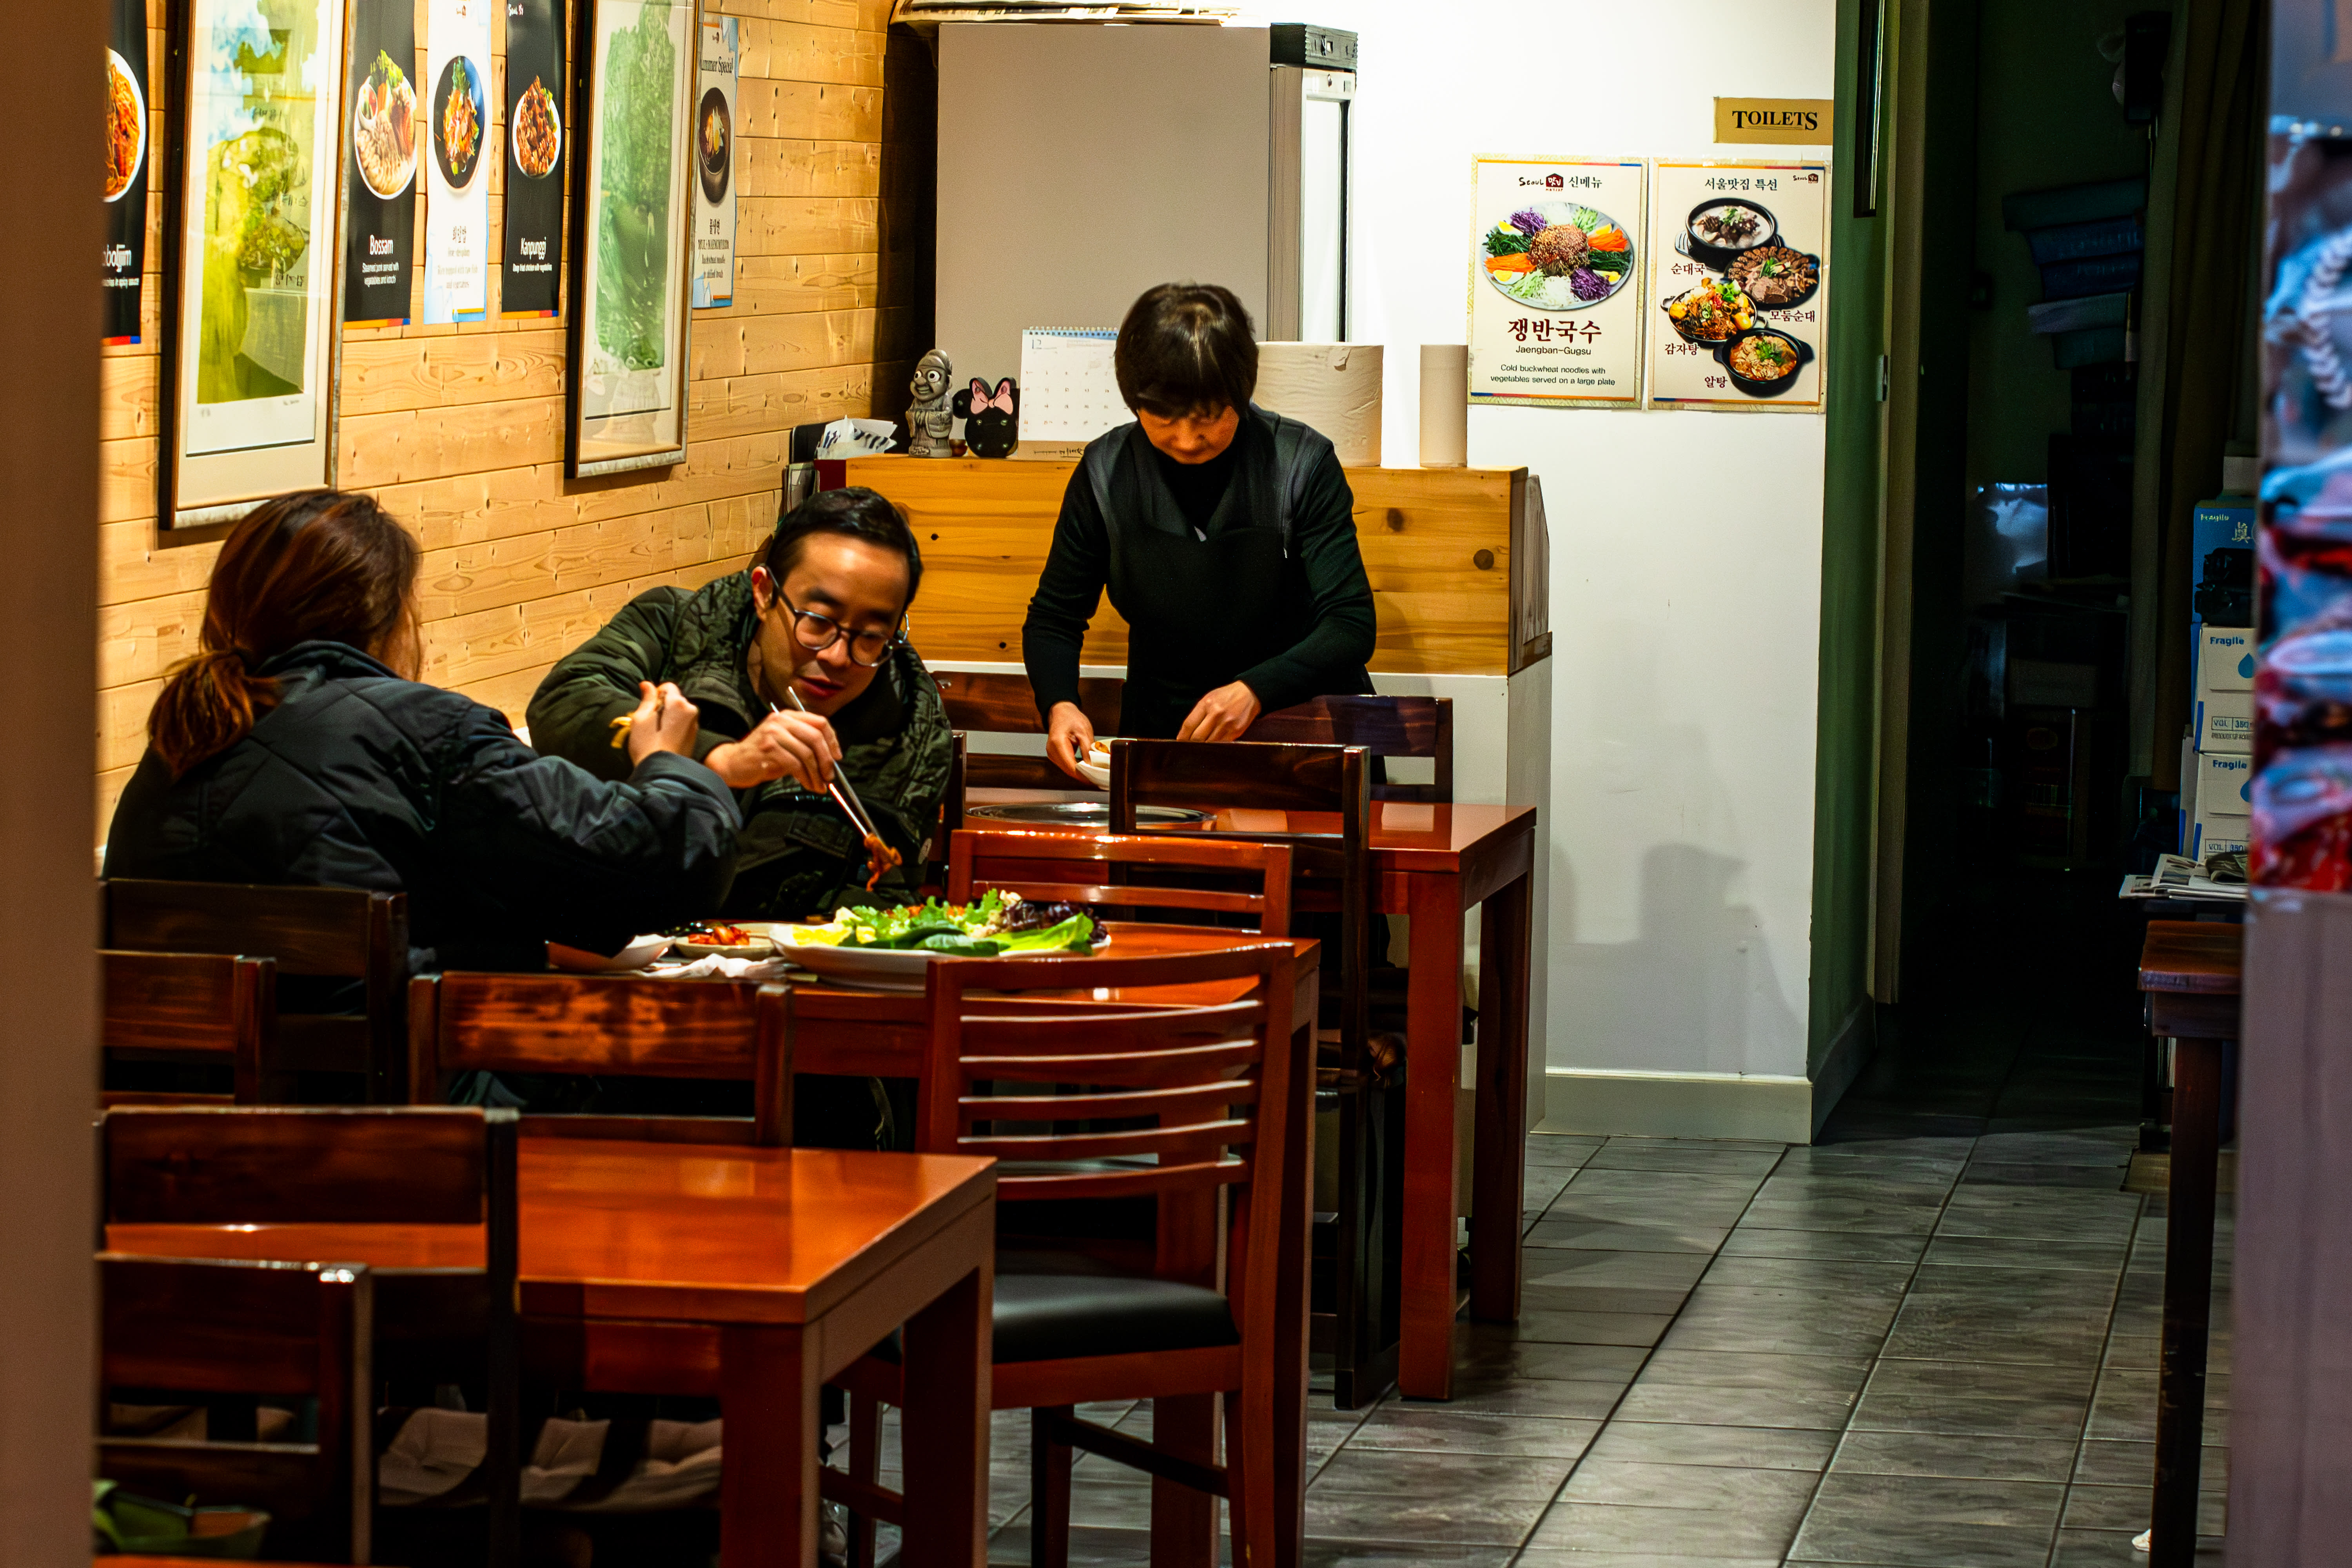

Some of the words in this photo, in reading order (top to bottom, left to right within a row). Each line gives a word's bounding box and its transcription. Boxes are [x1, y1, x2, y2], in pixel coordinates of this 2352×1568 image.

[701, 60, 717, 72] ummer
[719, 56, 733, 75] Special
[1732, 109, 1818, 131] TOILETS
[1519, 177, 1544, 186] Seoul
[1568, 176, 1602, 189] 신메뉴
[1705, 178, 1749, 190] 서울맛집
[1755, 179, 1778, 191] 특선
[370, 234, 394, 255] Bossam
[521, 236, 546, 260] Kanpunggi
[1671, 263, 1706, 275] 순대국
[1769, 310, 1816, 323] 모둠순대
[1507, 318, 1602, 344] 쟁반국수
[1515, 345, 1592, 356] Jaengban-Gugsu
[1665, 343, 1699, 355] 감자탕
[1490, 375, 1530, 384] vegetables
[1577, 377, 1595, 386] large
[1597, 378, 1615, 386] plate
[1704, 376, 1728, 388] 알탕
[2210, 637, 2245, 646] Fragile
[2213, 760, 2247, 770] Fragile
